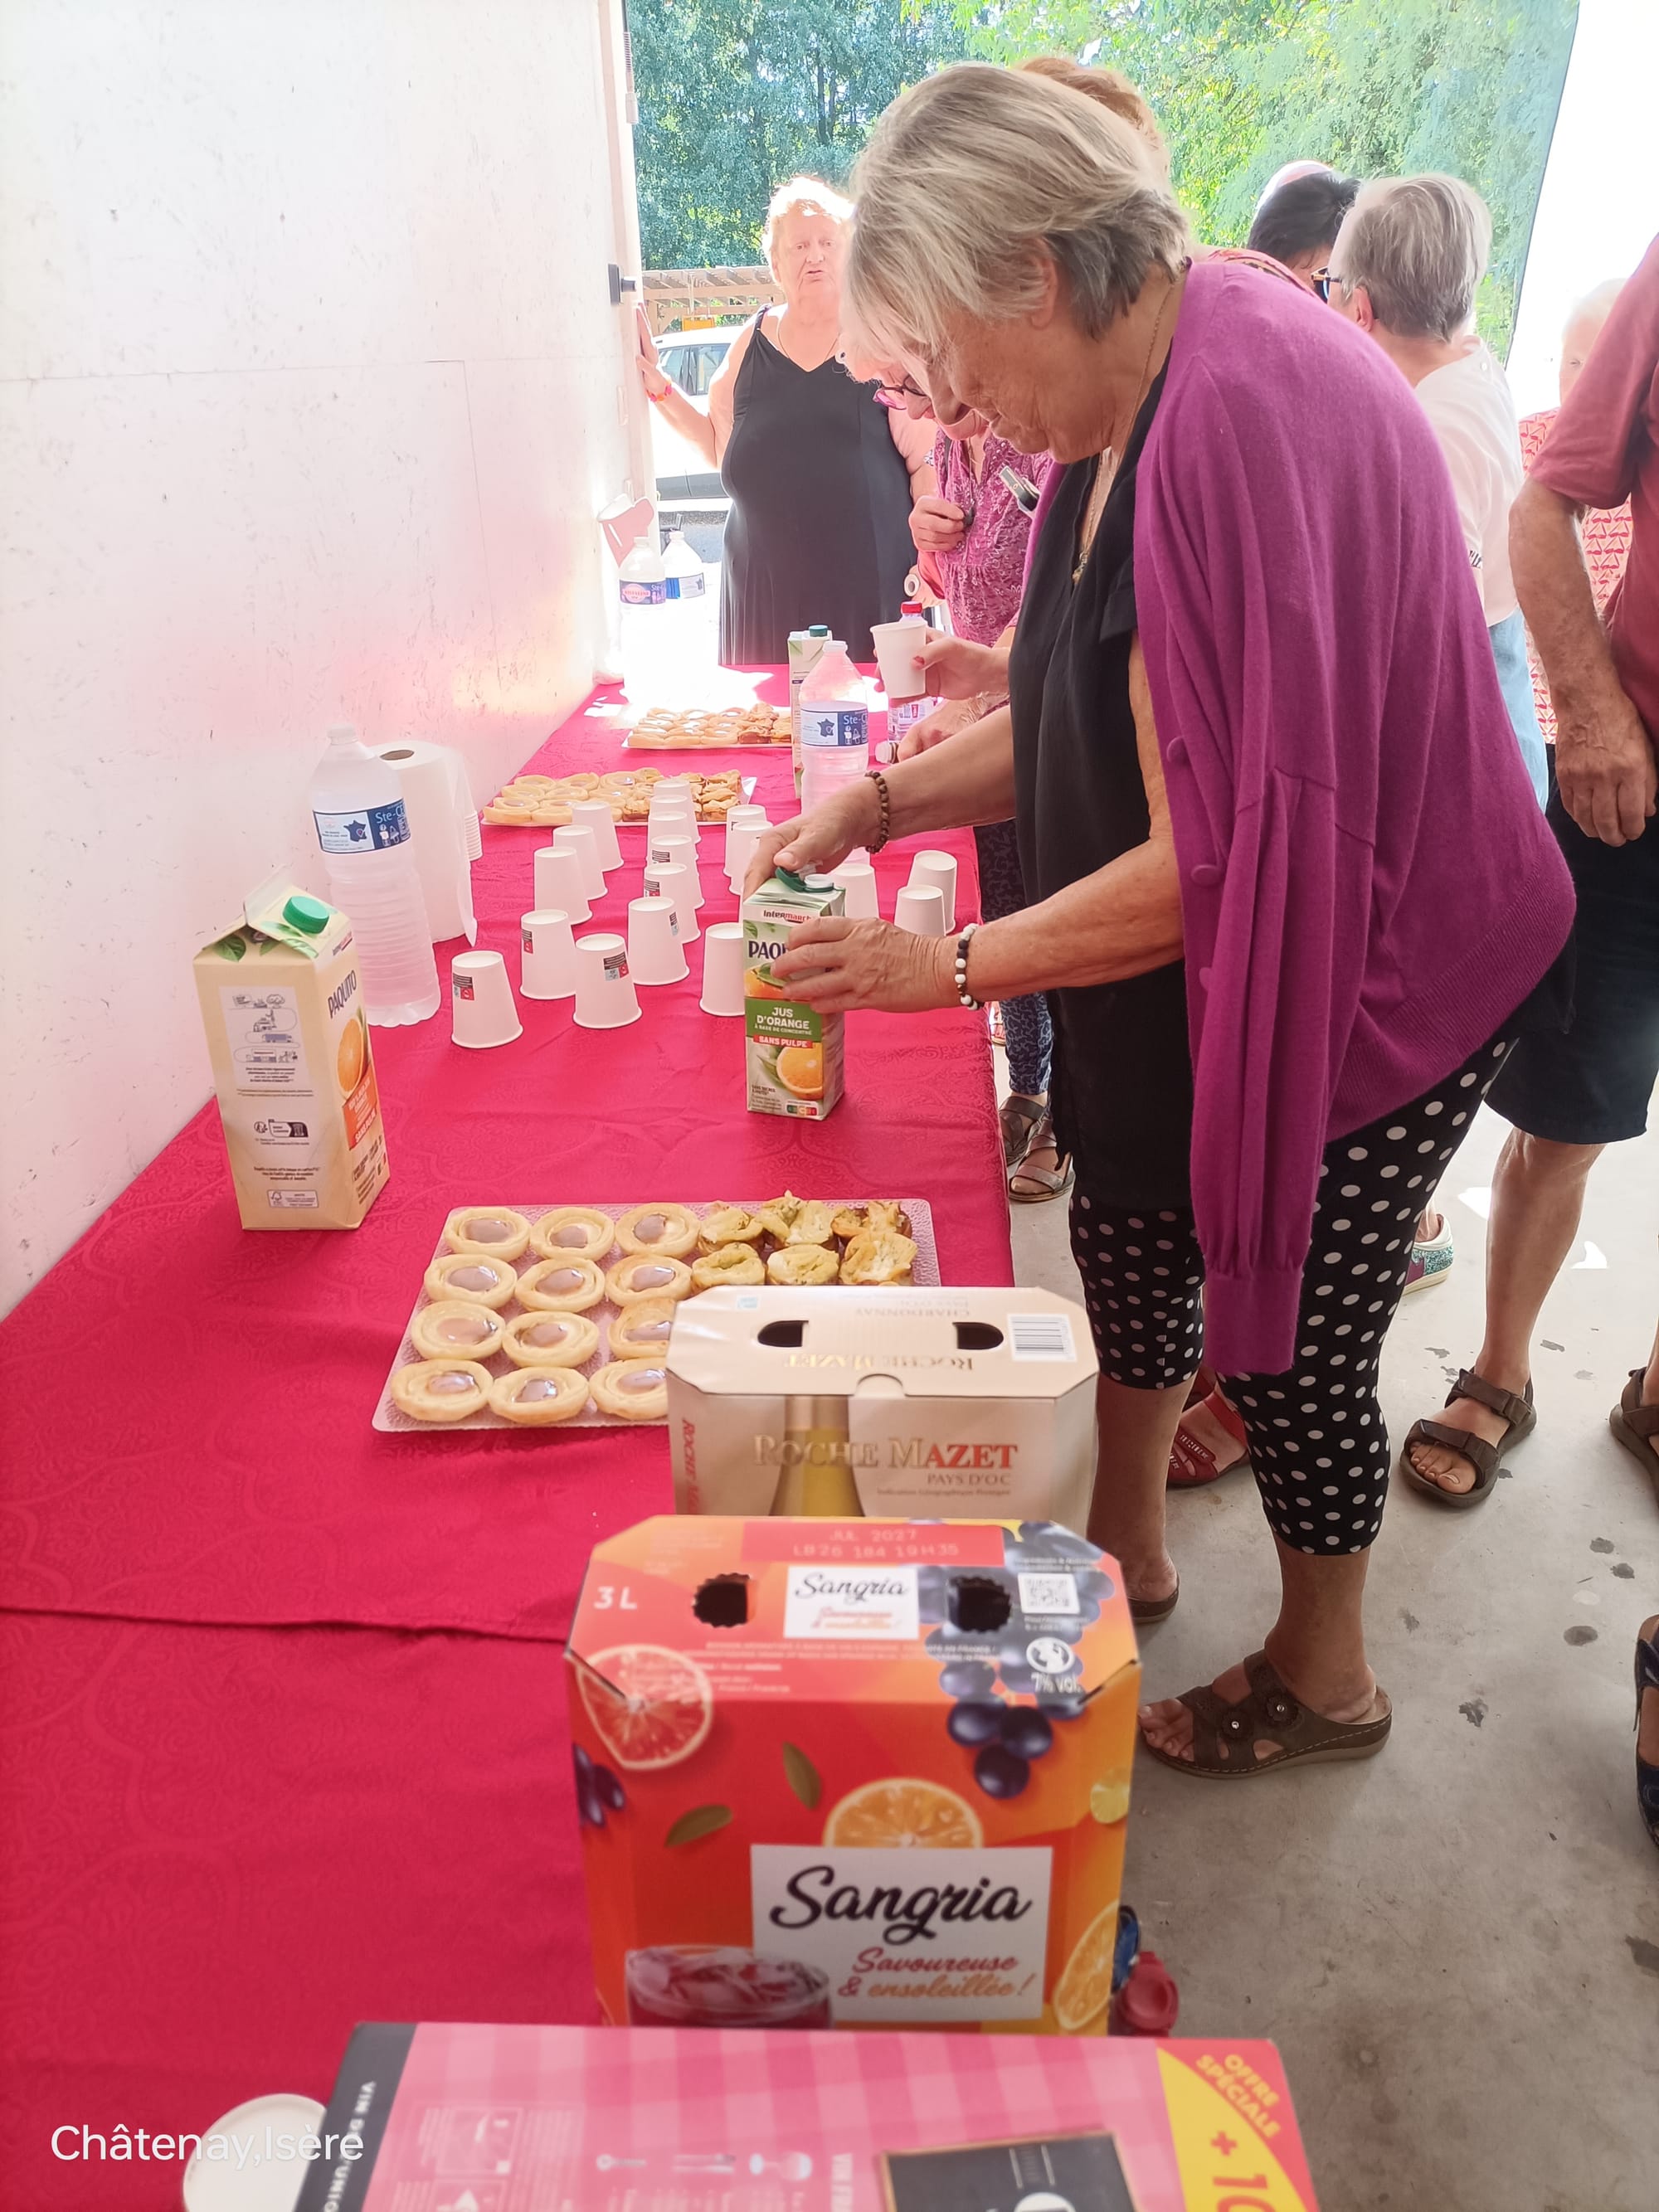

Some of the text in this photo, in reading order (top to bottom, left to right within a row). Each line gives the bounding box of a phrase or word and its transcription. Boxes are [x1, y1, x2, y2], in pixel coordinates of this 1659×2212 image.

[328, 970, 357, 1019] PAQUITO
[757, 1015, 810, 1029] D'ORANGE
[771, 1007, 793, 1018] JUS
[758, 1035, 808, 1048] SANS PULPE
[753, 1434, 1018, 1469] ROCHE MAZET
[927, 1473, 1011, 1485] PAYS D'OC
[871, 1529, 917, 1543] 2027
[795, 1573, 909, 1605] Sangria
[1031, 1672, 1053, 1693] 7%
[770, 1865, 1033, 1946] Sangria
[853, 1947, 1019, 1974] Savoureuse
[838, 1976, 863, 1997] &
[1224, 2054, 1280, 2107] OFFRE
